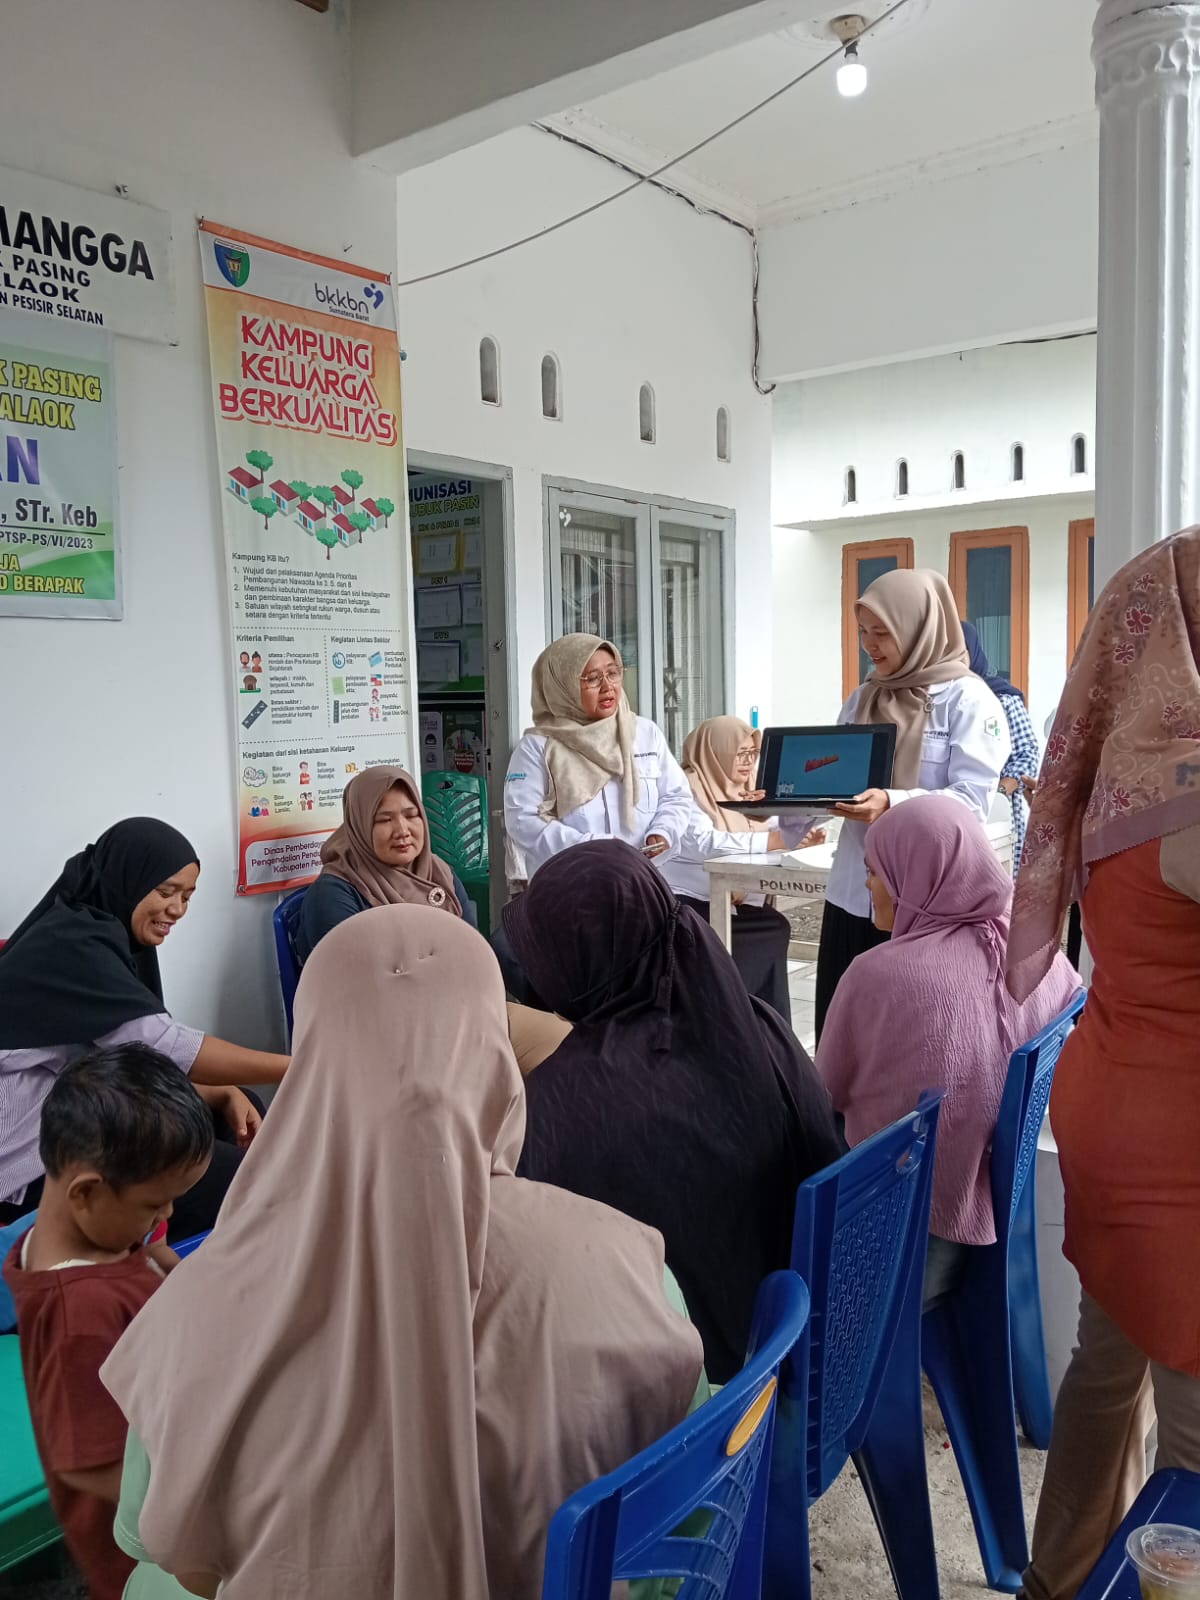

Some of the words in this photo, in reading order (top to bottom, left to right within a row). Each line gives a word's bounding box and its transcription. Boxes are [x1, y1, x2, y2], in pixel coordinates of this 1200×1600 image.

[12, 254, 91, 287] PASING
[0, 272, 80, 303] LAOK
[314, 282, 369, 314] bkkbn
[12, 294, 54, 315] PESISIR
[57, 304, 104, 326] SELATAN
[241, 315, 369, 371] KAMPUNG
[12, 361, 102, 402] PASING
[241, 351, 375, 404] KELUARGA
[219, 383, 391, 439] BERKUALITAS
[15, 498, 55, 524] STr.
[61, 503, 98, 528] Keb
[231, 552, 266, 563] Kampung
[242, 566, 265, 576] Wujud
[314, 571, 335, 580] Agenda
[243, 575, 288, 585] Pembangunan
[13, 574, 84, 594] BERAPAK
[243, 584, 278, 593] Memenuhi
[278, 586, 308, 594] kebutuhan
[244, 593, 258, 601] dan
[292, 595, 315, 603] karakter
[244, 601, 269, 610] Satuan
[245, 611, 267, 619] setara
[236, 634, 262, 642] Kriteria
[330, 636, 356, 644] Kegiatan
[242, 751, 275, 760] Kegiatan
[330, 745, 356, 753] Keluarga
[263, 846, 285, 856] Dinas
[251, 853, 301, 868] Pengendalian
[273, 862, 310, 874] Kabupaten
